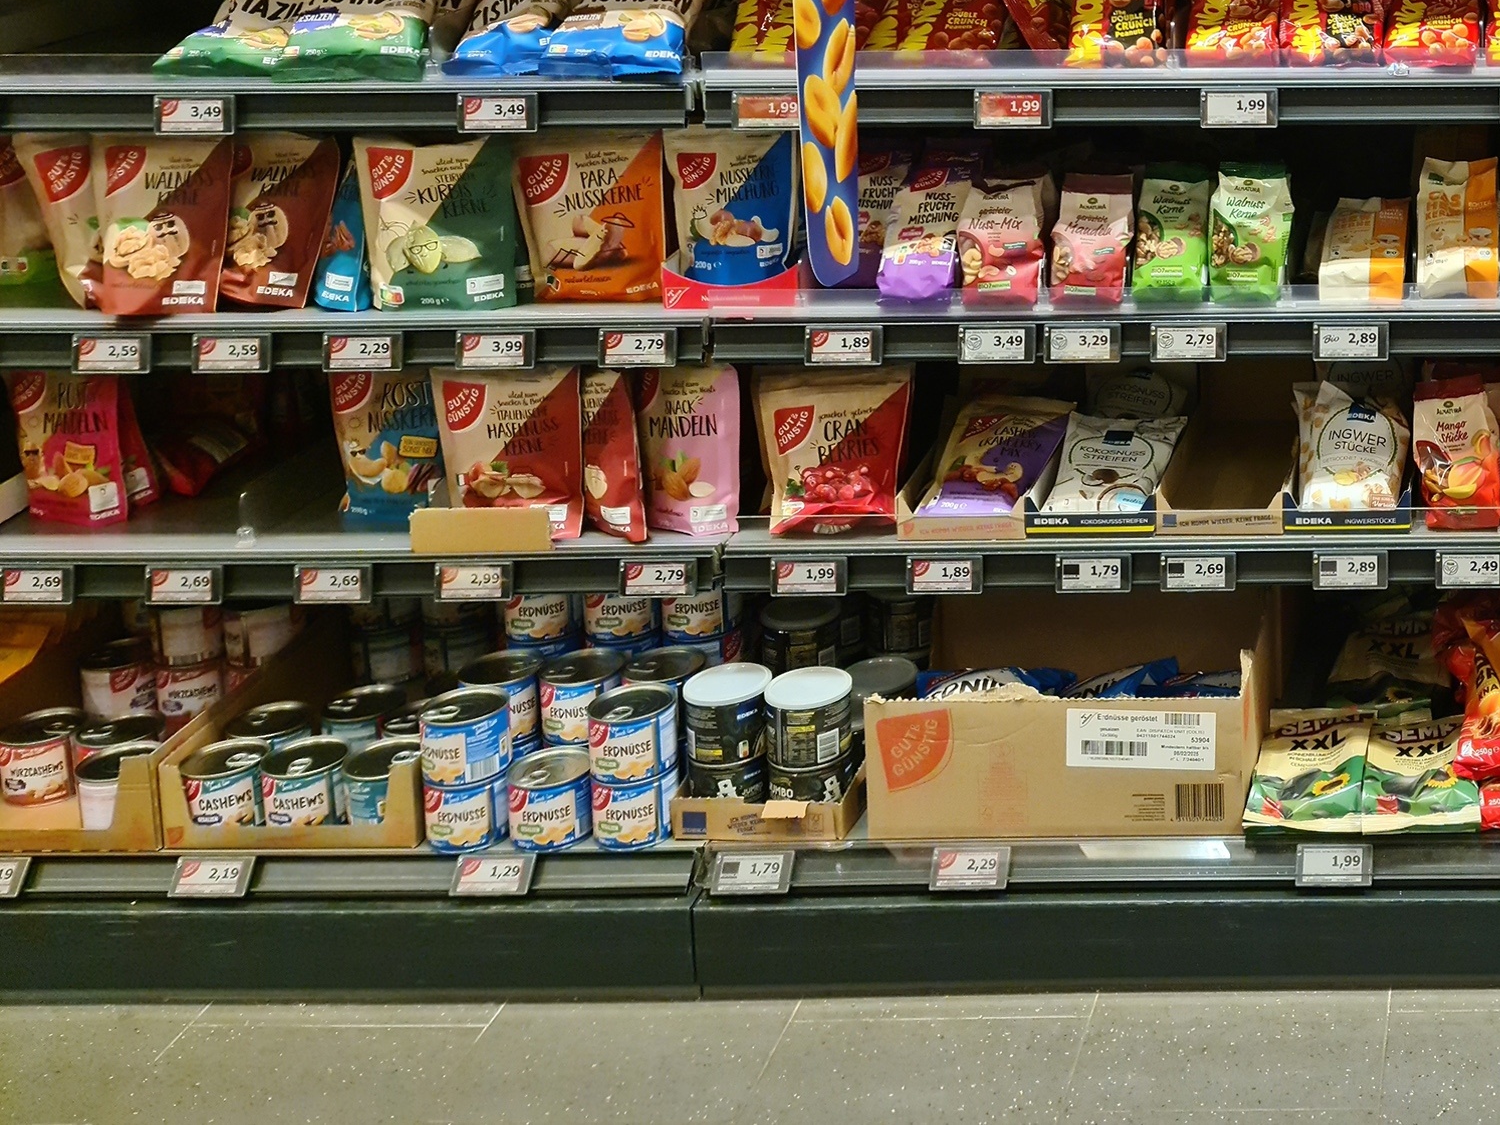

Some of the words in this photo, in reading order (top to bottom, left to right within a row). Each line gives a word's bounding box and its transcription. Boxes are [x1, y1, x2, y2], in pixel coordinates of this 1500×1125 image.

[494, 104, 525, 118] 3,49
[1010, 100, 1040, 114] 1,99
[579, 171, 624, 189] PARA-
[565, 188, 644, 210] NUSSKERNE
[924, 192, 956, 204] NUSS-
[917, 201, 958, 215] FRUCHT
[907, 211, 960, 226] MISCHUNG
[257, 286, 294, 298] EDEKA
[633, 338, 664, 352] 2,79
[840, 336, 871, 350] 1,89
[1078, 334, 1108, 346] 3,29
[1348, 332, 1377, 346] 2,89
[359, 342, 390, 356] 2,29
[1327, 428, 1387, 447] INGWER
[1080, 445, 1147, 461] KOKOSNUSS
[1333, 441, 1377, 454] STÜCKE
[1033, 517, 1069, 525] EDEKA
[1295, 517, 1332, 525] EDEKA
[1343, 517, 1397, 525] INGWERSTÜCKE
[941, 566, 971, 580] 1,89
[1195, 563, 1224, 577] 2,69
[1469, 560, 1499, 574] 2,49
[806, 567, 835, 582] 1,99
[329, 575, 360, 589] 2,69
[1097, 712, 1128, 723] Erdnüsse
[1130, 713, 1159, 723] geröstet
[1191, 736, 1210, 744] 53904
[1291, 732, 1347, 751] XXL
[602, 738, 652, 758] ERDNÜSSE
[436, 805, 487, 824] ERDNÜSSE
[1331, 854, 1361, 869] 1,99
[490, 865, 521, 880] 1,29
